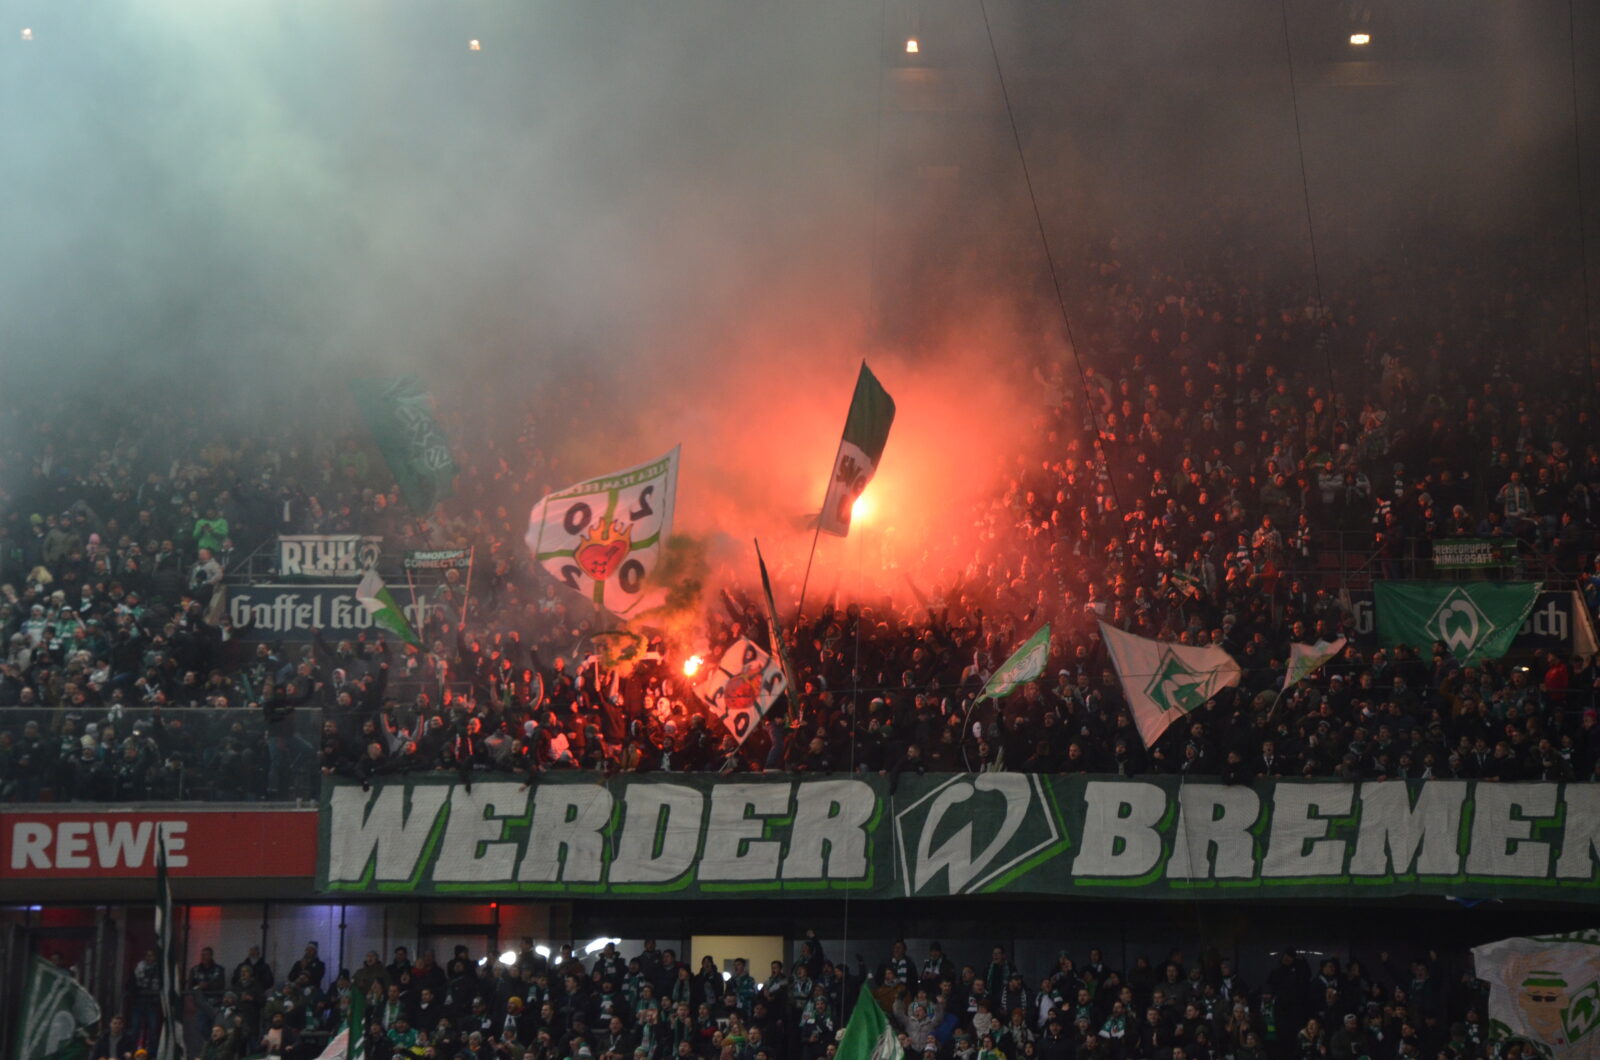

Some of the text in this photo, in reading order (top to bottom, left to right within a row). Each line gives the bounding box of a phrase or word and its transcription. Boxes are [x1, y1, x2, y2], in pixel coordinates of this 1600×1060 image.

[403, 558, 472, 568] CONNECTION
[230, 593, 325, 632] Gaffel
[11, 820, 188, 870] REWE
[328, 779, 877, 886] WERDER
